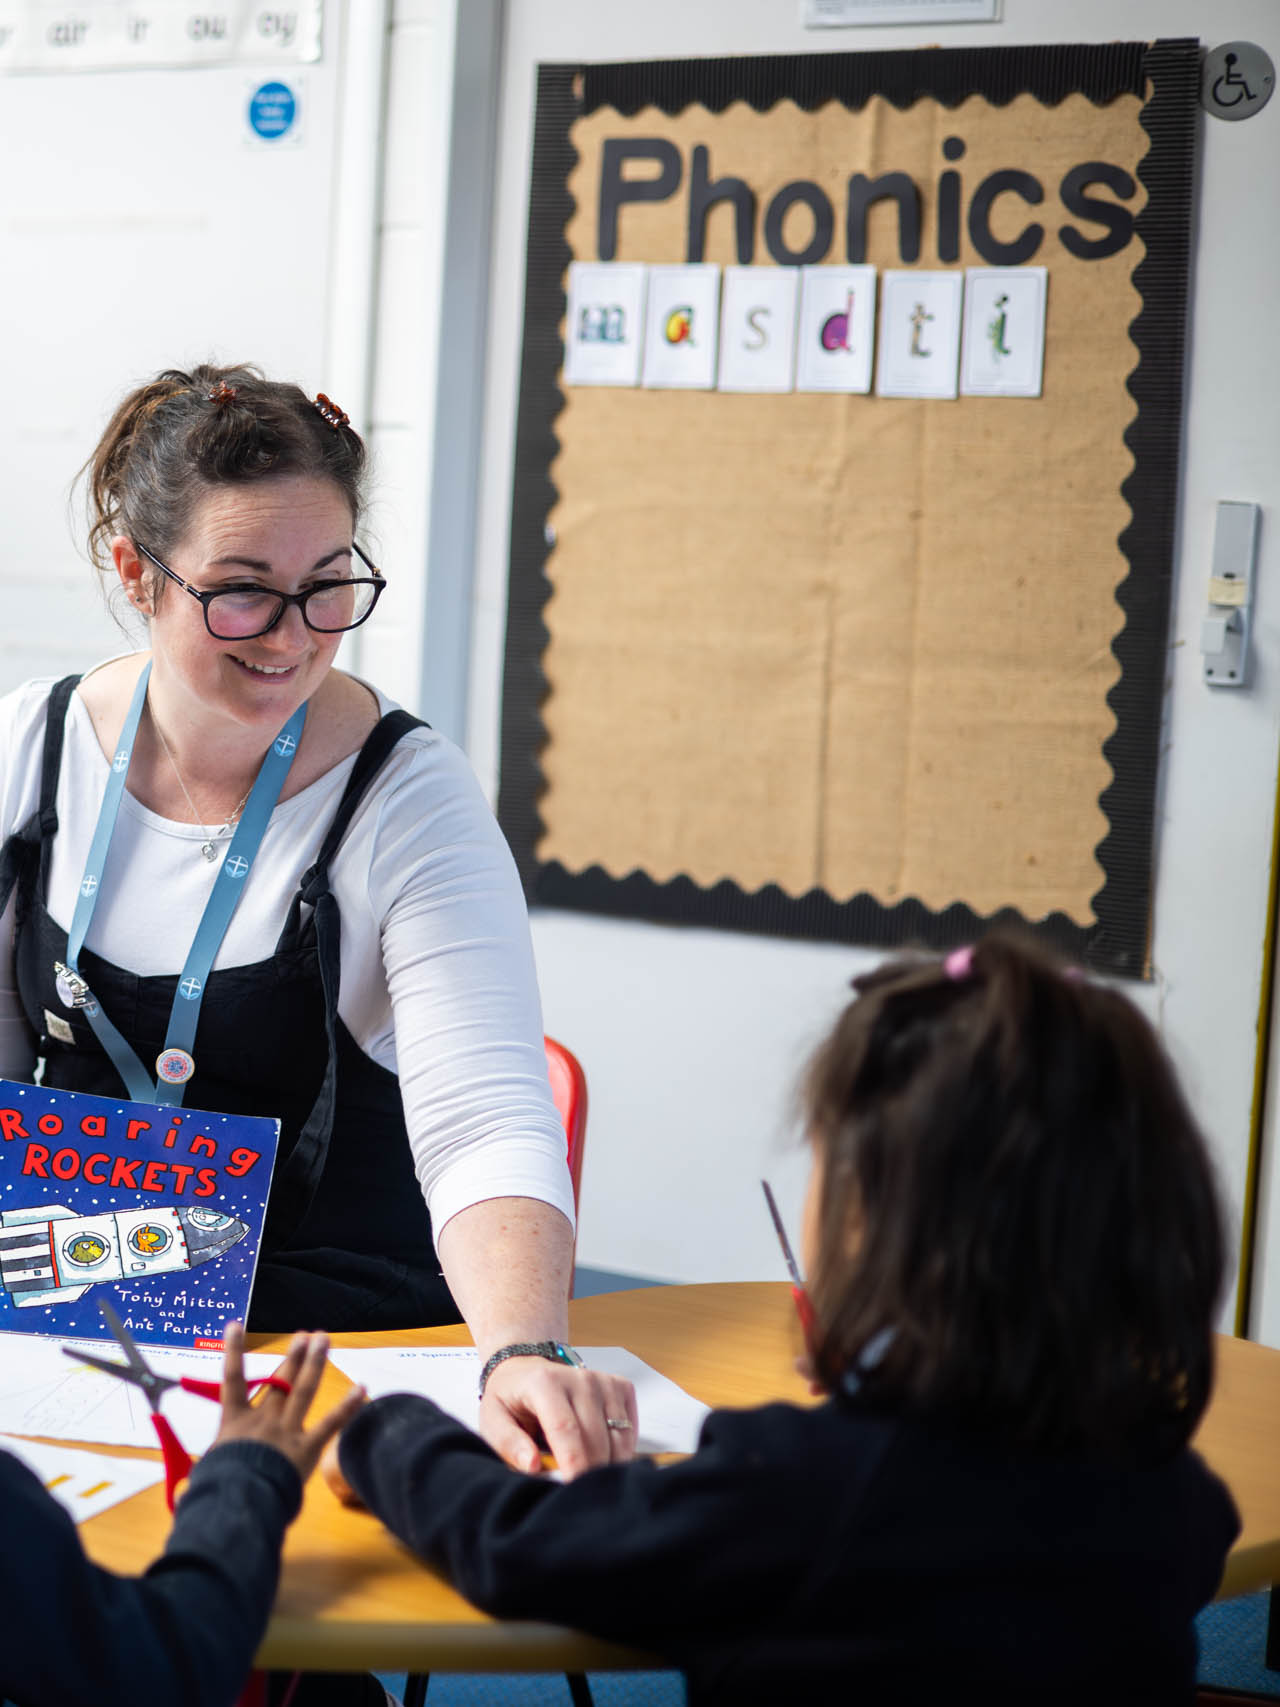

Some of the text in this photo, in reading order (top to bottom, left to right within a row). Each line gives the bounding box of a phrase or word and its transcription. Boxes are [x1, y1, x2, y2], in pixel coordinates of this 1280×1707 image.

[597, 135, 1137, 266] Phonics
[578, 304, 626, 344] m
[663, 304, 697, 346] a
[743, 307, 771, 351] s
[820, 286, 854, 352] d
[910, 302, 935, 357] t
[21, 1142, 218, 1199] ROCKETS
[118, 1289, 236, 1310] Tony Mitton
[159, 1310, 185, 1319] and
[122, 1317, 223, 1337] Ant Parker
